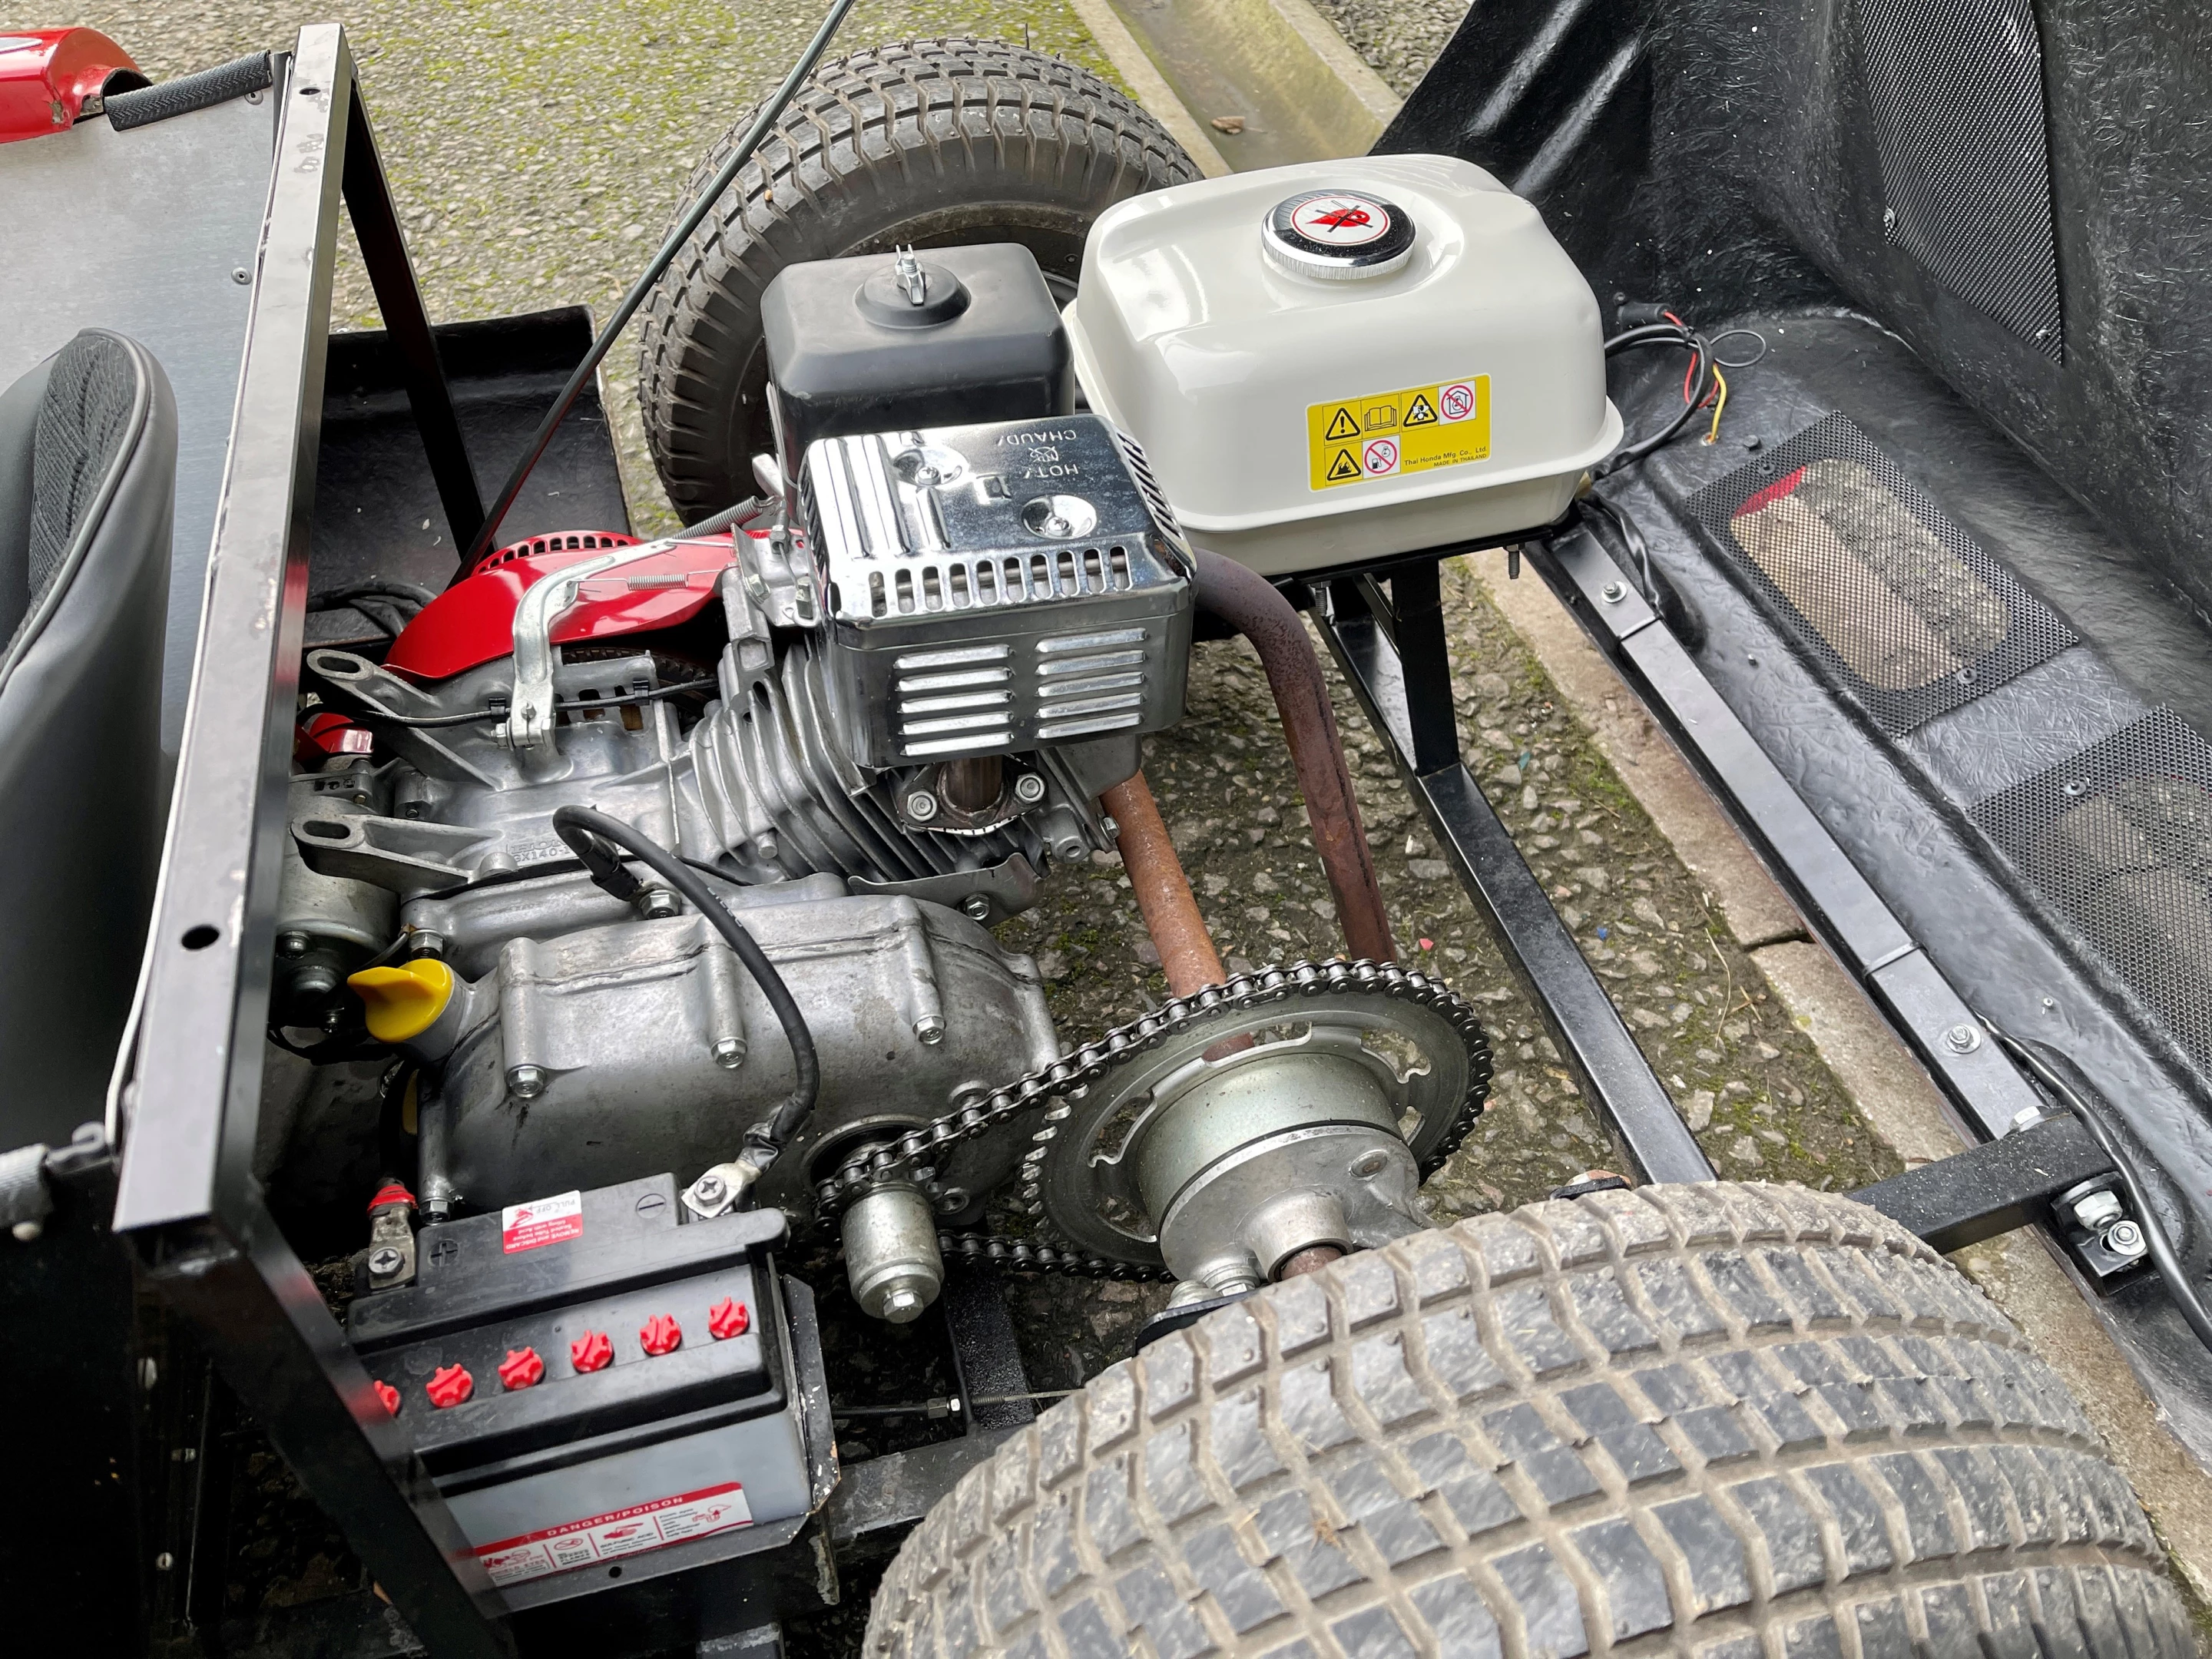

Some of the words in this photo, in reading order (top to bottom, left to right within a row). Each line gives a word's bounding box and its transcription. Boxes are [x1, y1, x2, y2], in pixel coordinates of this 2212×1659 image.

[998, 429, 1076, 446] CHAUD!
[1420, 455, 1442, 463] Honda
[1460, 453, 1487, 462] THAILAND
[1023, 463, 1079, 479] HOT!
[511, 839, 568, 854] HON
[514, 846, 571, 863] GX140-1
[550, 1224, 572, 1233] Sealed
[551, 1229, 579, 1239] REMOVE
[505, 1238, 537, 1250] DISCARD
[547, 1497, 683, 1536] DANGER/POISON
